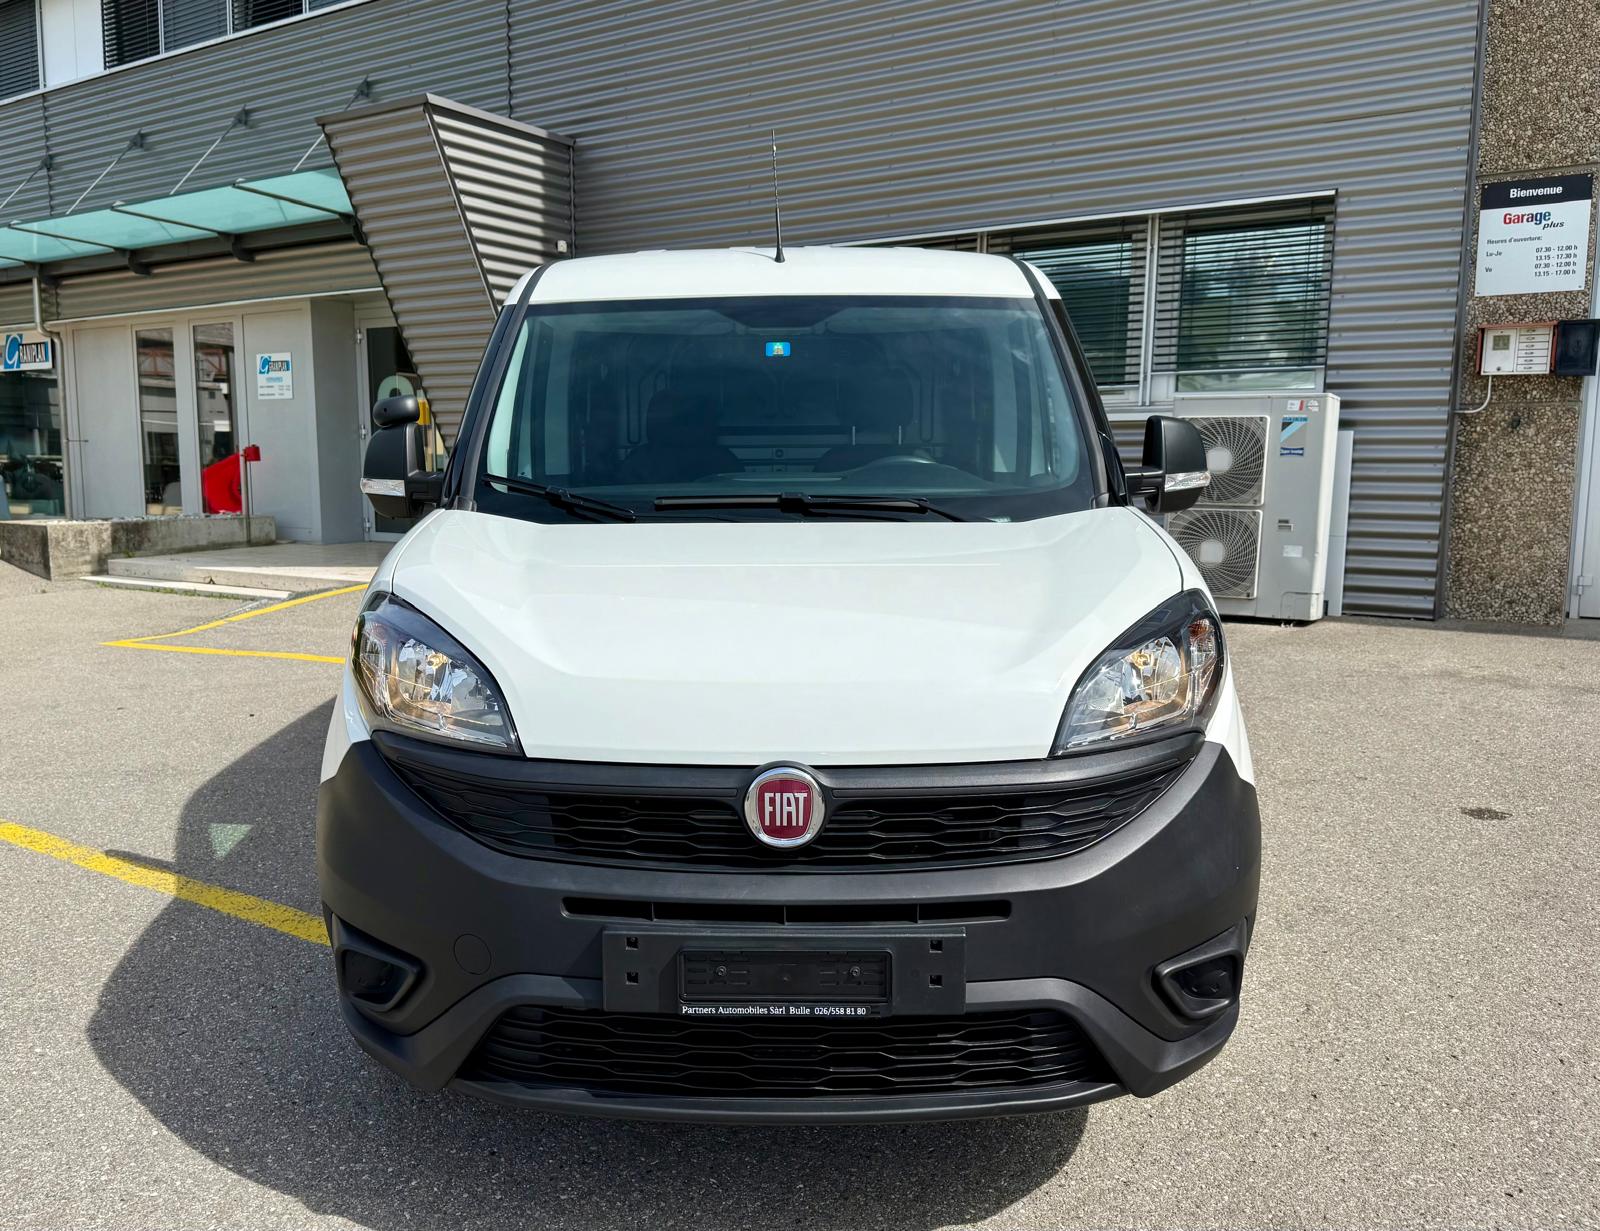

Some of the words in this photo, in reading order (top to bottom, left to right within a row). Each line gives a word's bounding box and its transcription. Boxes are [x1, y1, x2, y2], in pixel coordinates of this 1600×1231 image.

[1509, 186, 1563, 199] Bienvenue
[1503, 211, 1552, 226] Garage
[1542, 221, 1565, 231] plus
[1486, 238, 1508, 246] Heures
[764, 792, 808, 827] FIAT
[682, 1006, 716, 1014] Partners
[718, 1006, 768, 1014] Automobiles
[789, 1006, 811, 1015] Bulle
[814, 1006, 845, 1016] 026/558
[846, 1007, 855, 1015] 81
[856, 1007, 867, 1015] 80
